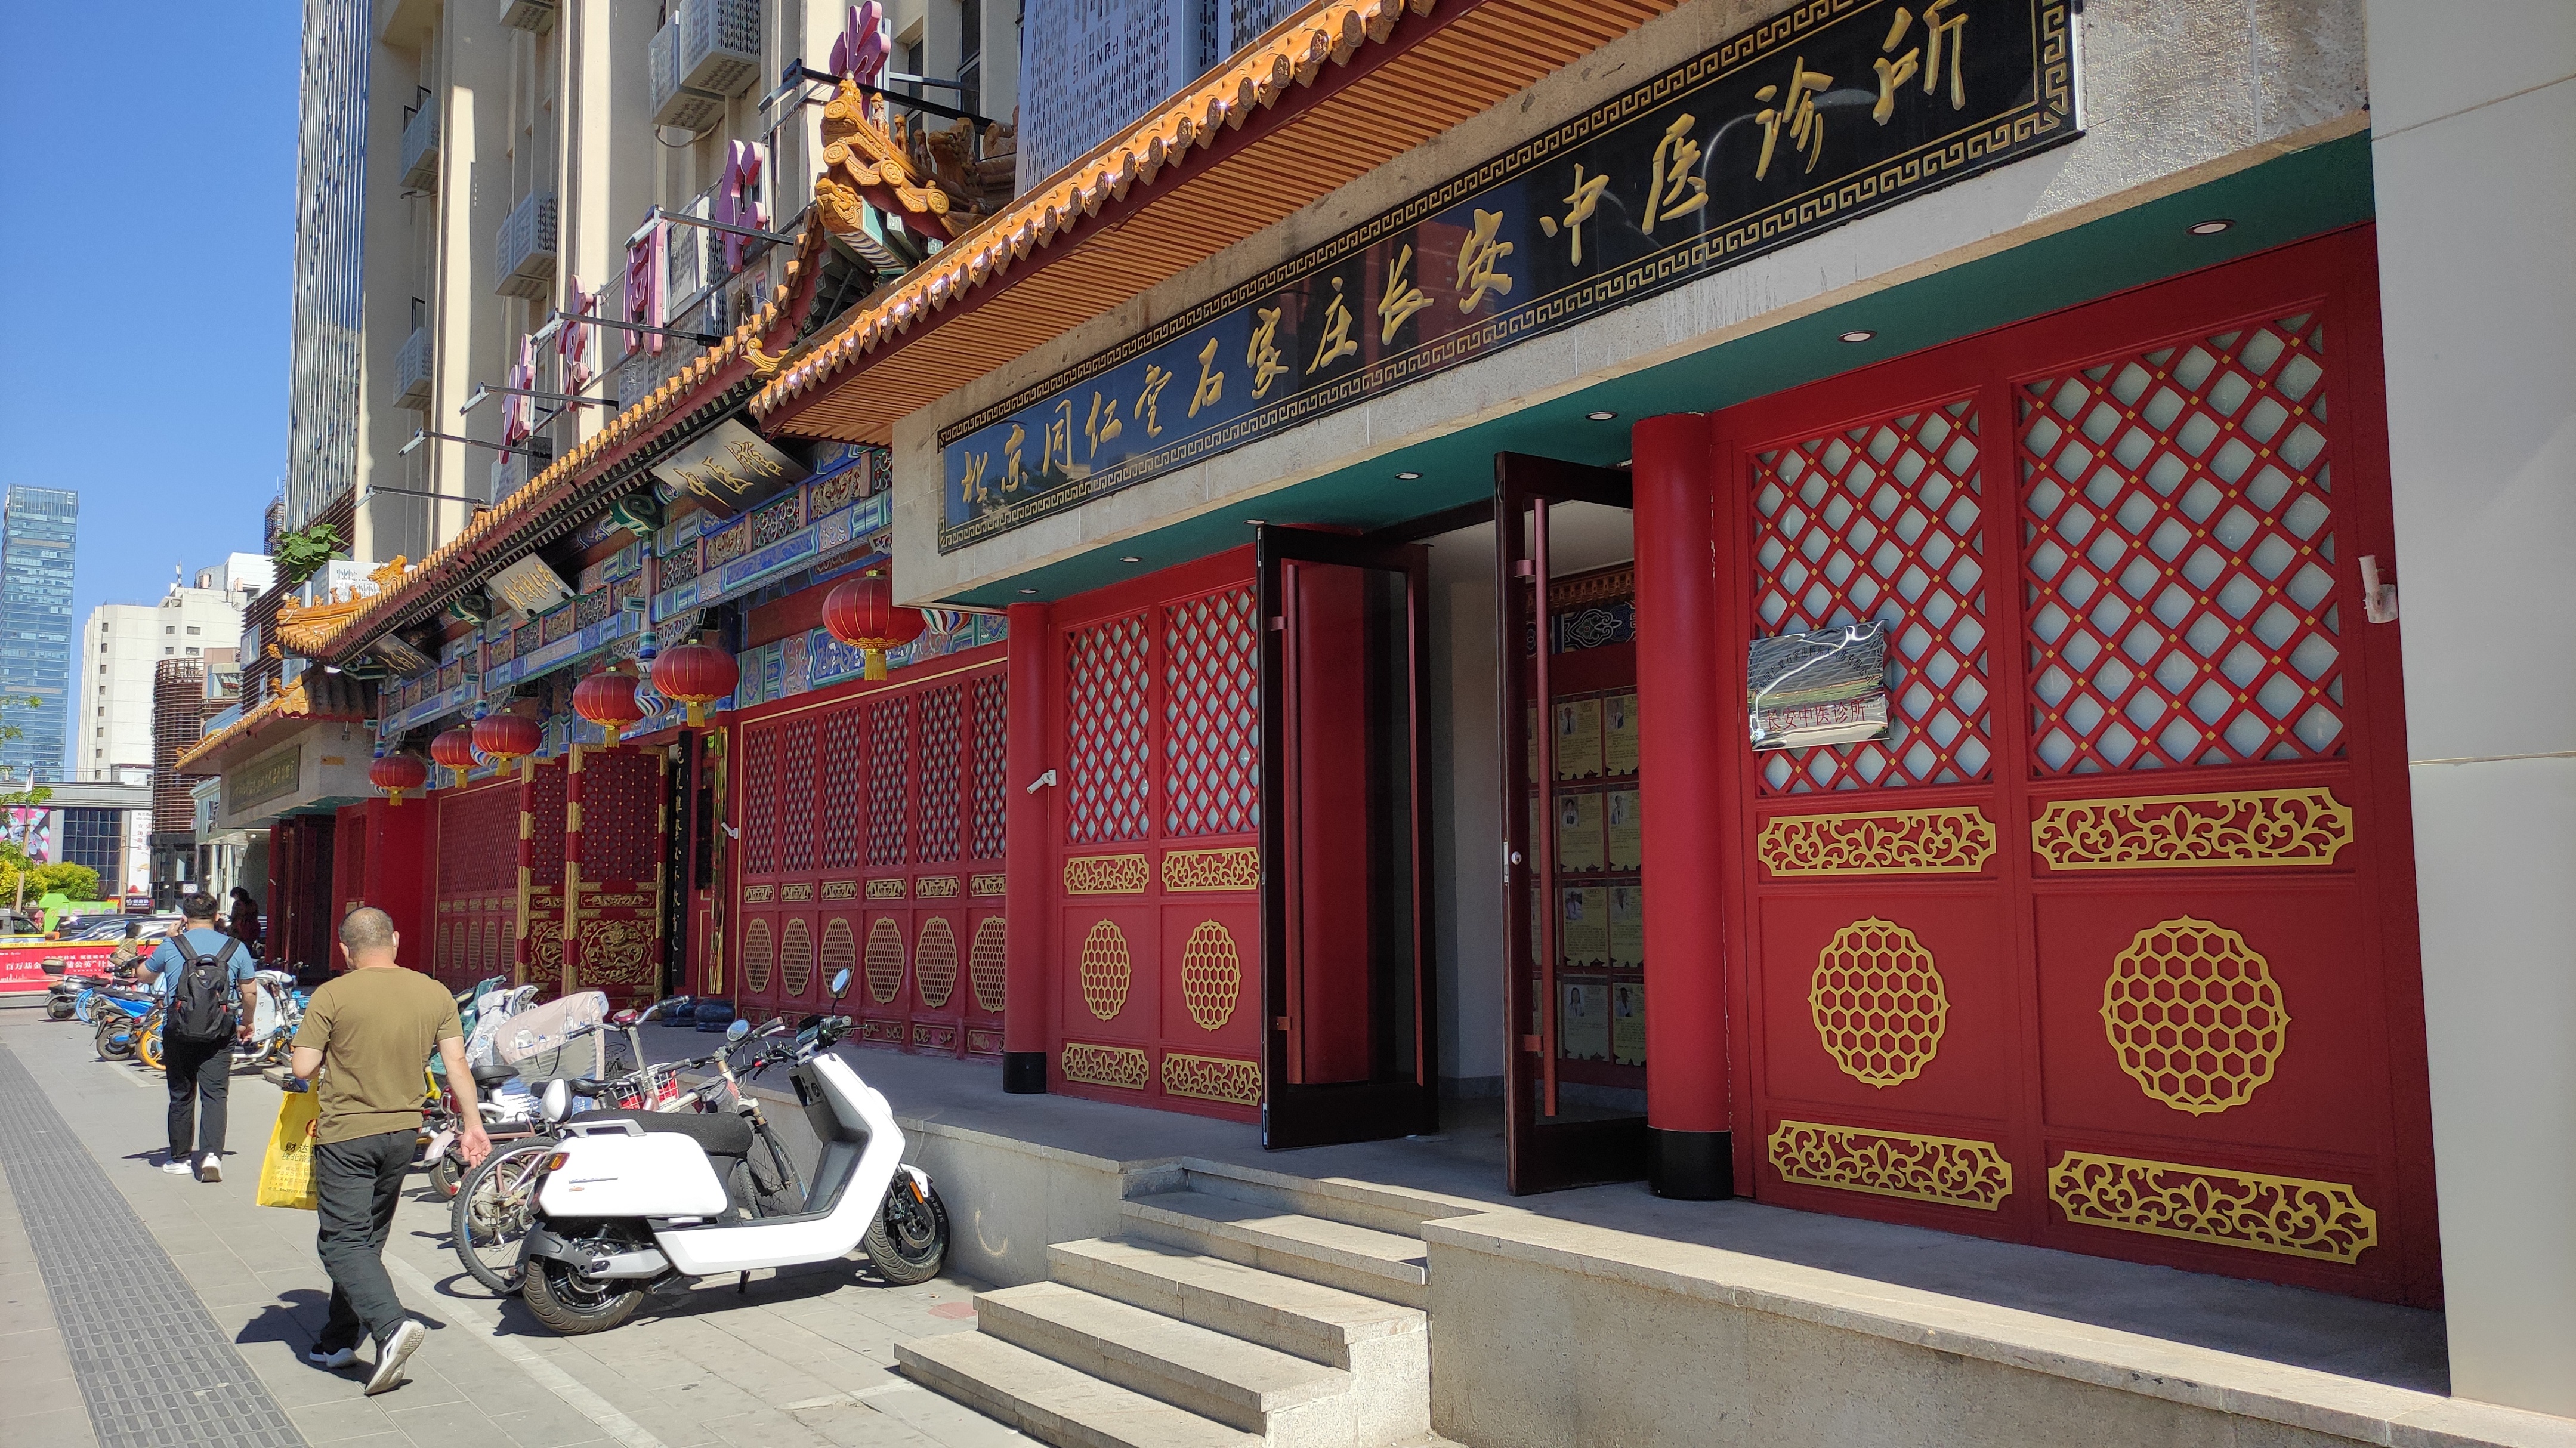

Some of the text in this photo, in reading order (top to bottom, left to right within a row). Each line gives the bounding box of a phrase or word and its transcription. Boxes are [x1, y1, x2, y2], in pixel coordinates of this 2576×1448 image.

[962, 0, 1969, 503] 北京同仁堂石家庄长安中医诊所
[1765, 699, 1866, 731] 长安中医诊所
[285, 1141, 314, 1154] 财达
[930, 1196, 944, 1223] AXXIS
